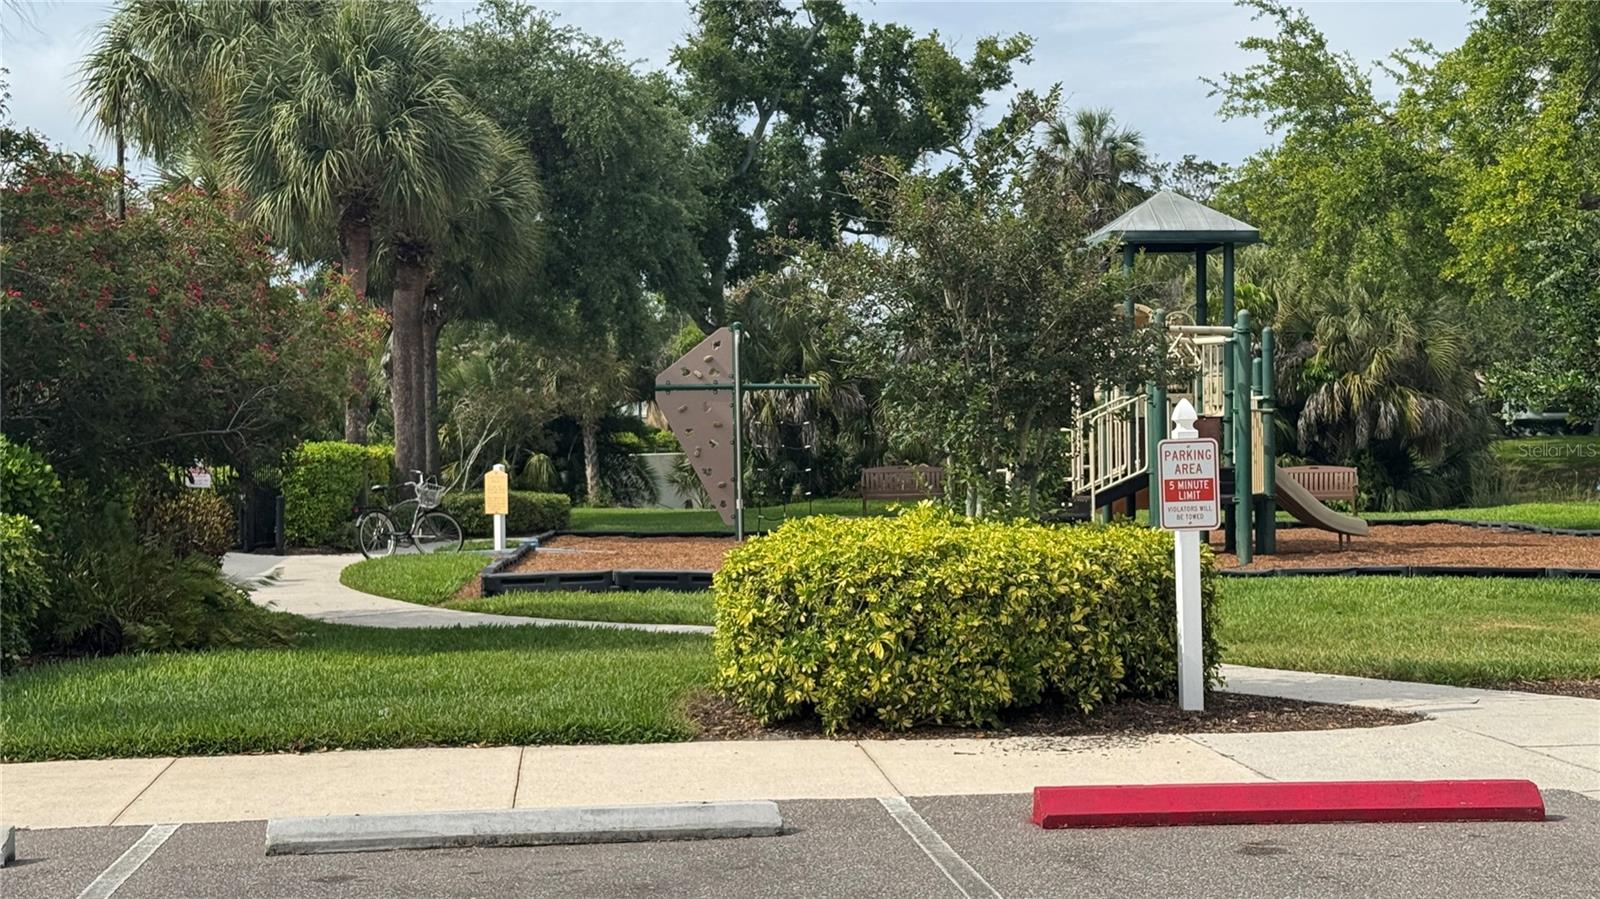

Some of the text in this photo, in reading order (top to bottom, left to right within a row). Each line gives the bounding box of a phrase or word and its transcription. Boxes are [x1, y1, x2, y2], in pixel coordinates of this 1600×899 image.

[1164, 449, 1212, 461] PARKING
[1175, 464, 1202, 474] AREA
[1169, 480, 1209, 490] 5 MINUTE
[1178, 490, 1200, 500] LIMIT
[1167, 505, 1198, 513] VIOLATORS
